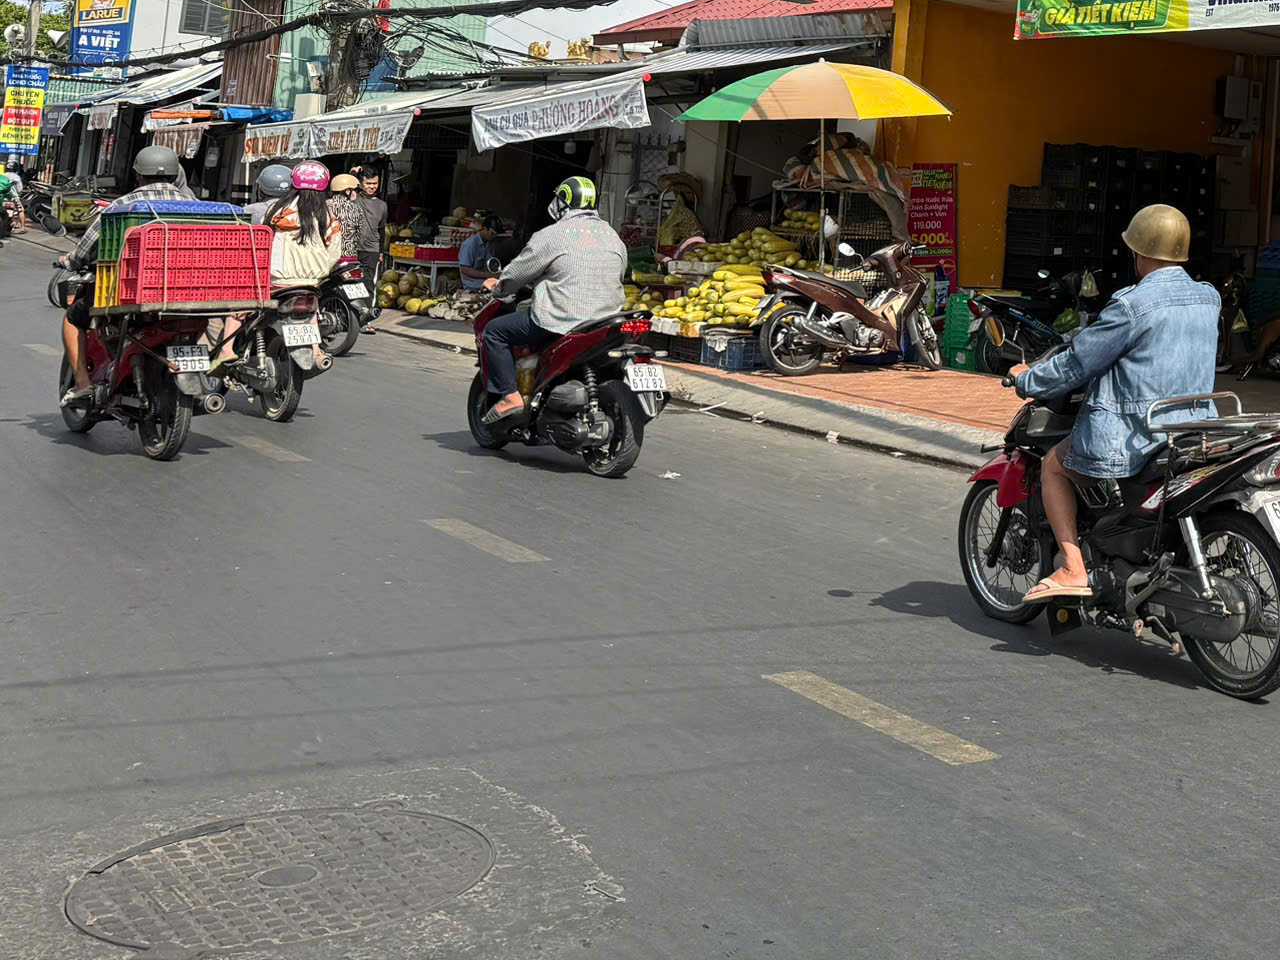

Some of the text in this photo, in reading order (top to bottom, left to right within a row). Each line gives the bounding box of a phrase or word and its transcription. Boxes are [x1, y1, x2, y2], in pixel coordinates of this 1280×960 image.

[82, 8, 121, 20] LARUE
[1044, 2, 1077, 26] GIÁ
[1268, 3, 1280, 13] 1976
[78, 34, 121, 51] A VIỆT
[924, 203, 949, 211] Sunlight
[172, 346, 203, 358] 95-F3
